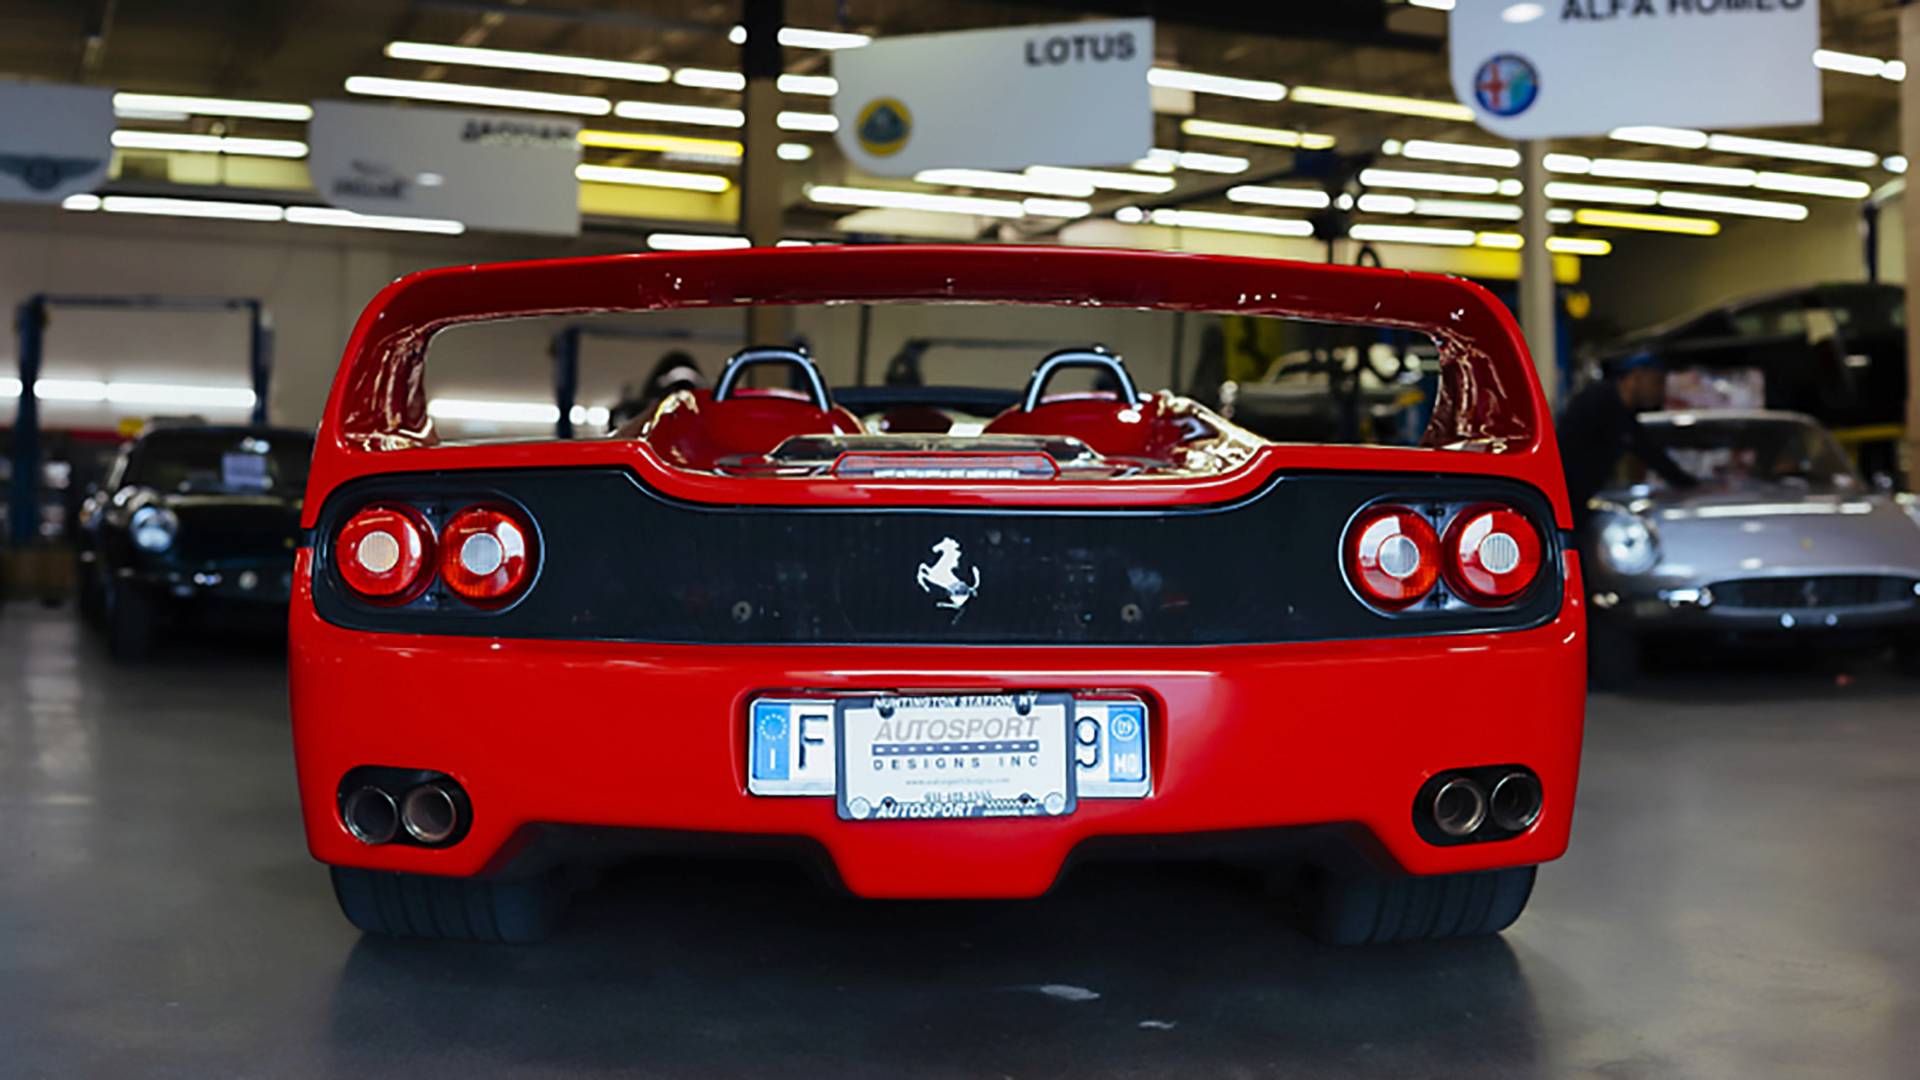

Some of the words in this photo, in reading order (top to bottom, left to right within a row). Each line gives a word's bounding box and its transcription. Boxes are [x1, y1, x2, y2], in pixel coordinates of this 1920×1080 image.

[1025, 32, 1136, 66] LOTUS
[799, 714, 828, 769] F
[875, 716, 1040, 742] AUTOSPORT
[873, 757, 980, 771] DESIGNS
[999, 755, 1038, 767] INC
[876, 802, 975, 818] AUTOSPORT
